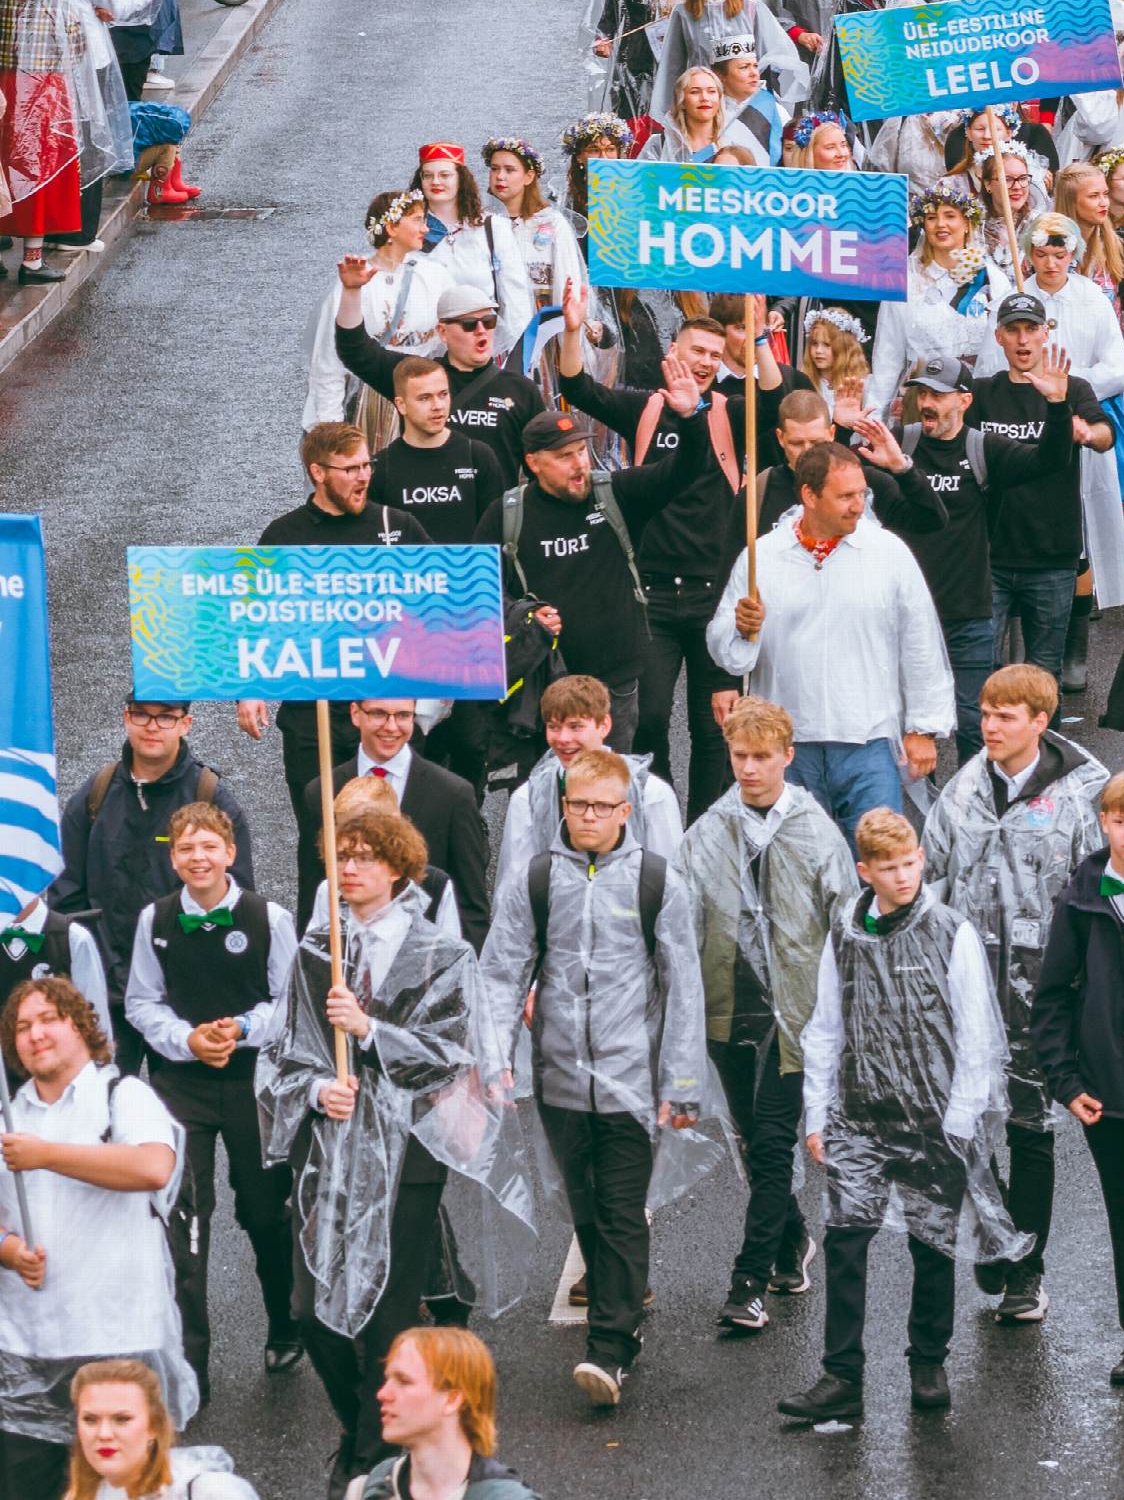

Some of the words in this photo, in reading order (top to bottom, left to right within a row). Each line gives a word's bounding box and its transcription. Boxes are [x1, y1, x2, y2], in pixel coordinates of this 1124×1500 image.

[902, 8, 1047, 42] ÜLE-EESTILINE
[905, 28, 1051, 60] NEIDUDEKOOR
[925, 56, 1041, 98] LEELO
[657, 185, 839, 220] MEESKOOR
[637, 220, 860, 276] HOMME
[402, 485, 462, 505] LOKSA
[540, 532, 591, 558] TÜRI
[181, 573, 249, 597] EMLS
[255, 569, 449, 596] ÜLE-EESTILINE
[229, 599, 404, 623] POISTEKOOR
[236, 636, 402, 680] KALEV
